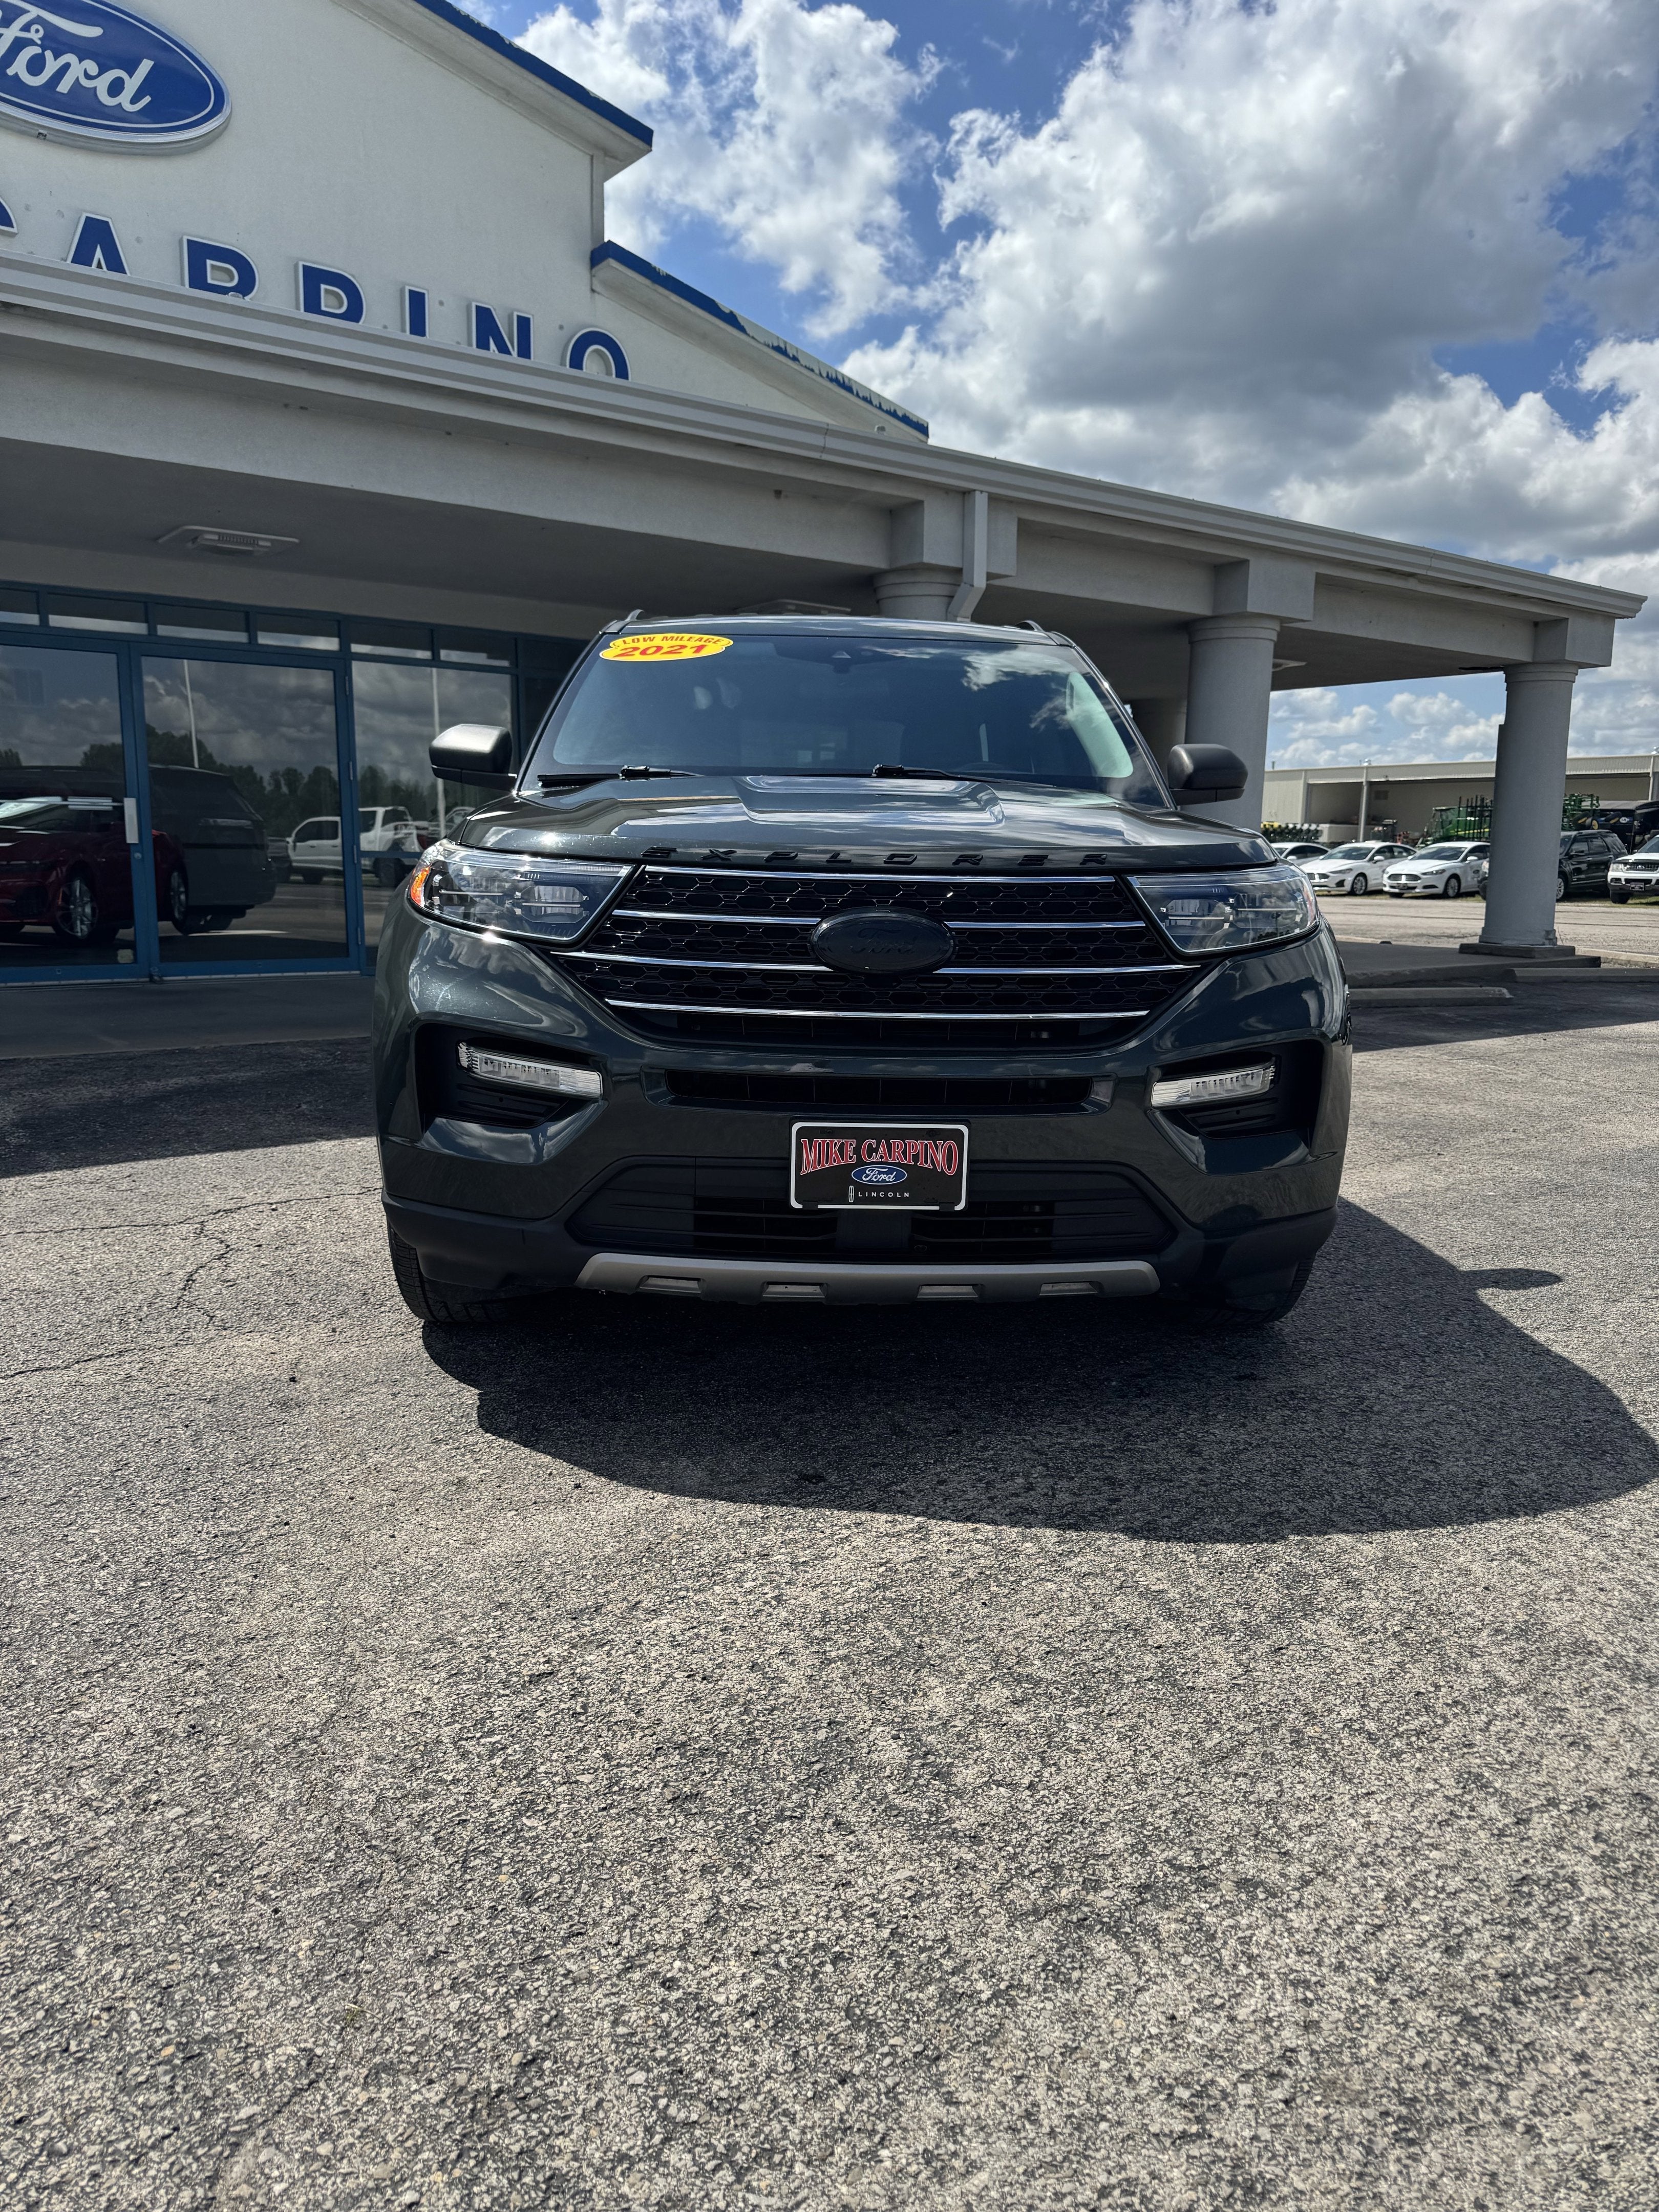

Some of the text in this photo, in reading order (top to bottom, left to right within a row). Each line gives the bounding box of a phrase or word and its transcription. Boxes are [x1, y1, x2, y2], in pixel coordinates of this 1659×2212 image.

[622, 636, 725, 645] LOW MILEAGE
[612, 644, 709, 658] 2021
[641, 846, 1108, 866] EXPLORER
[848, 927, 920, 954] Ford
[800, 1139, 959, 1176] MIKE CARPINO
[862, 1167, 897, 1182] Ford
